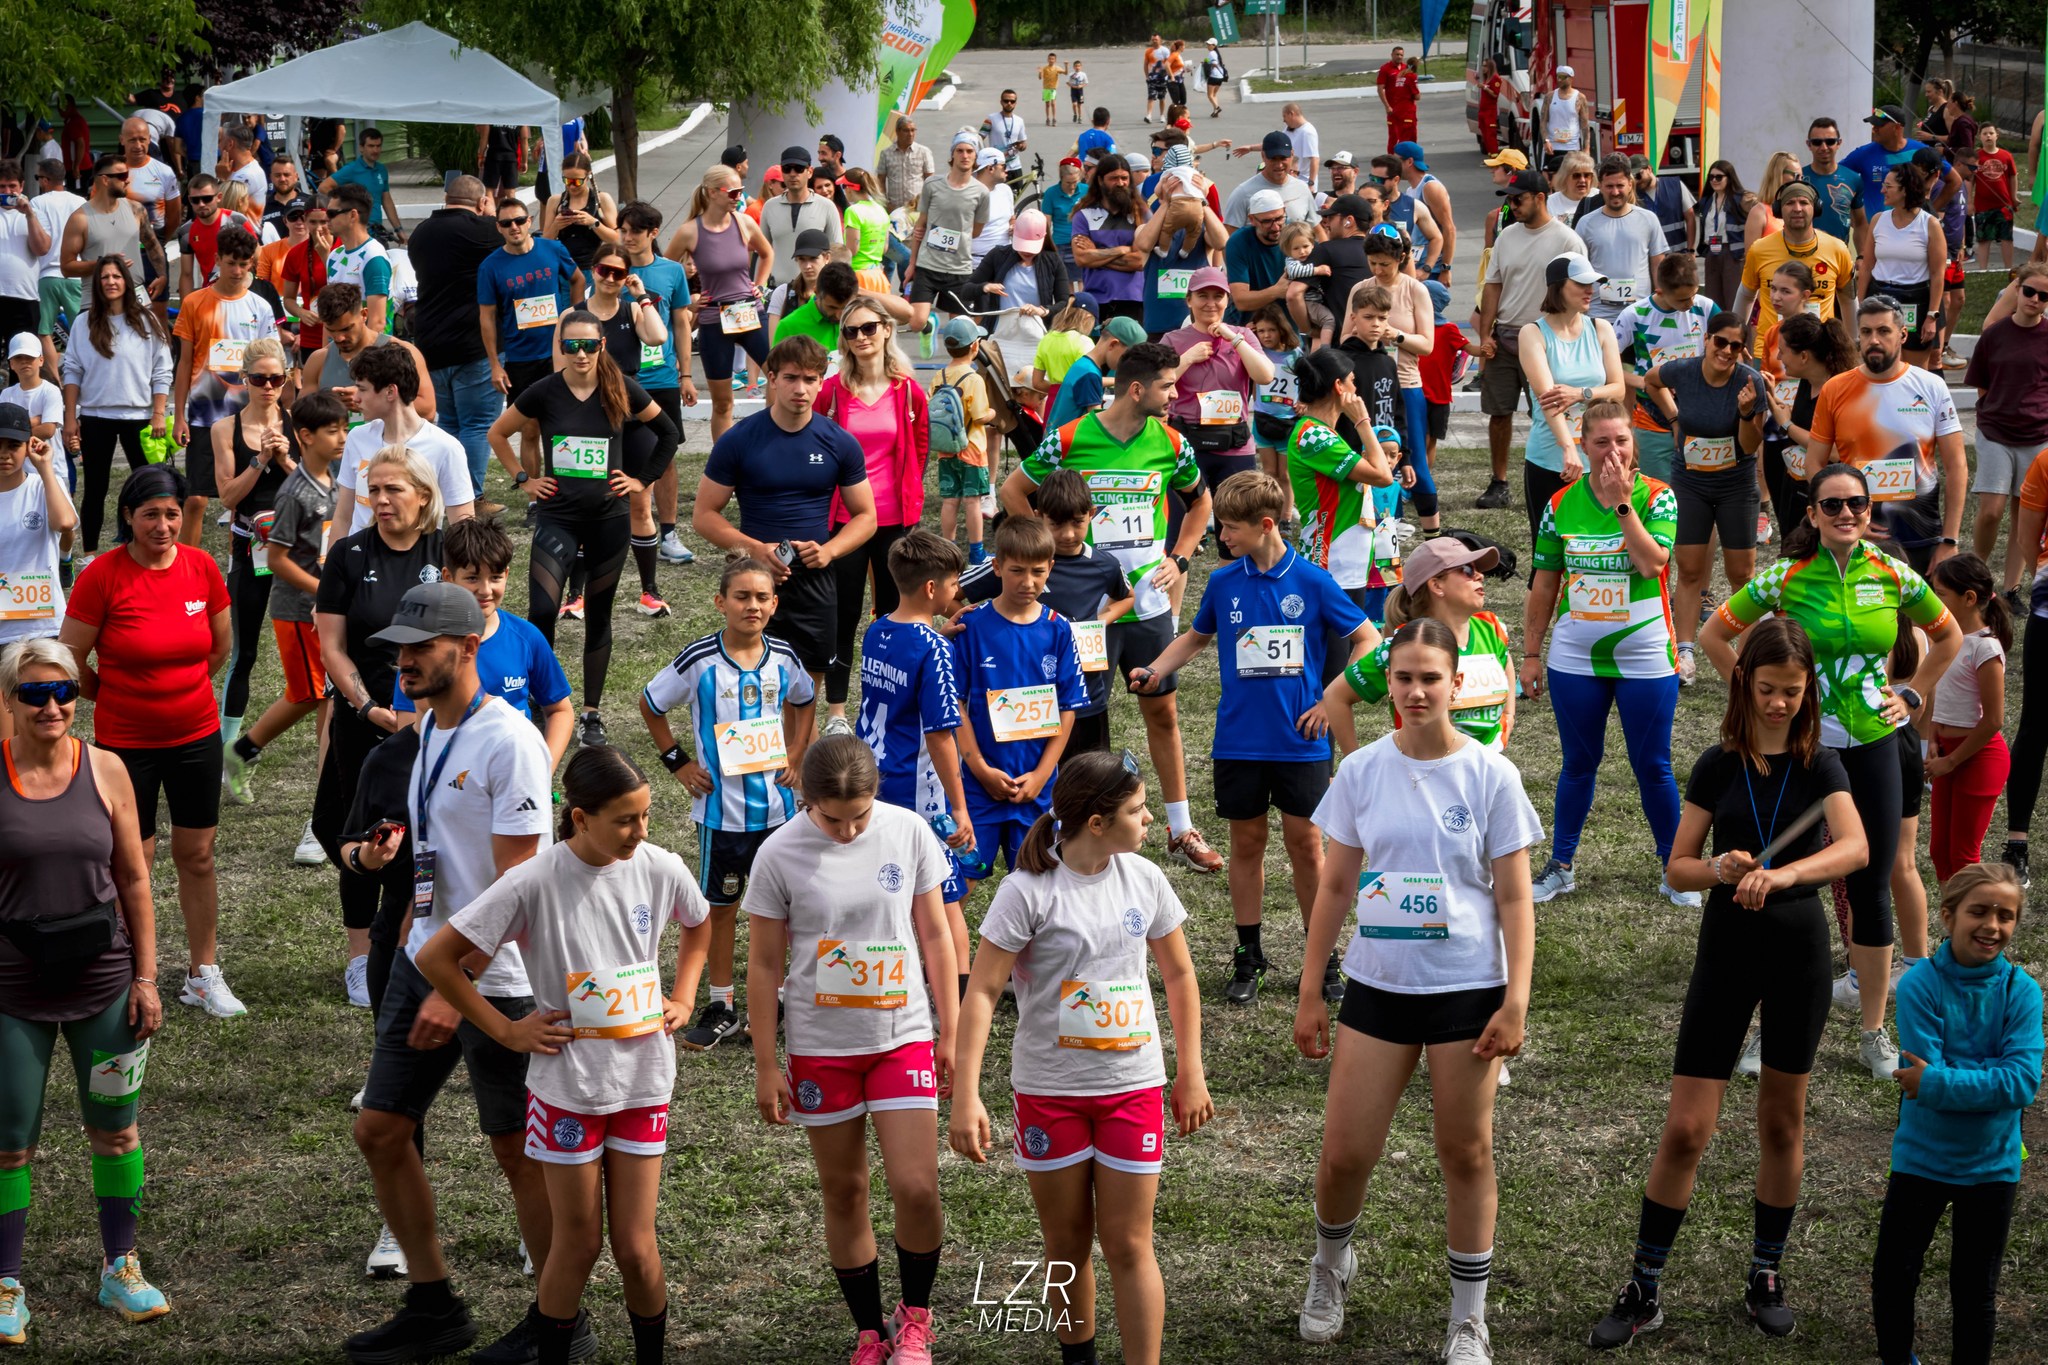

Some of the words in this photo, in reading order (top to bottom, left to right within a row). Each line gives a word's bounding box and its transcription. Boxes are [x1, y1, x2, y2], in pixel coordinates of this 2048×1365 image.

[888, 22, 929, 46] HARVEST
[1675, 0, 1685, 51] ATENA
[881, 32, 924, 57] RUN
[941, 235, 955, 246] 38
[1173, 277, 1188, 289] 10
[1616, 287, 1631, 298] 12
[530, 303, 555, 317] 202
[734, 309, 756, 323] 266
[1907, 312, 1915, 323] 8
[225, 349, 243, 361] 20
[644, 345, 660, 357] 52
[1270, 378, 1288, 394] 22
[1214, 400, 1239, 414] 206
[573, 448, 604, 465] 153
[1701, 447, 1733, 461] 272
[1091, 476, 1142, 487] CATENA
[1877, 471, 1912, 487] 227
[1089, 494, 1123, 505] ACING
[1120, 515, 1141, 533] 11
[1391, 534, 1399, 554] 9
[1568, 540, 1619, 551] CATENA
[12, 585, 52, 604] 308
[1588, 588, 1625, 606] 201
[1230, 611, 1243, 624] 50
[1078, 634, 1103, 655] 298
[1267, 639, 1291, 660] 51
[861, 655, 907, 687] LLENIUM
[1352, 661, 1367, 685] TEAM
[1014, 700, 1053, 723] 257
[744, 730, 782, 756] 304
[1400, 895, 1438, 914] 456
[851, 959, 903, 986] 314
[605, 981, 655, 1016] 217
[1095, 1000, 1144, 1028] 307
[906, 1069, 933, 1089] 78
[649, 1112, 667, 1132] 17
[1141, 1133, 1155, 1152] 9
